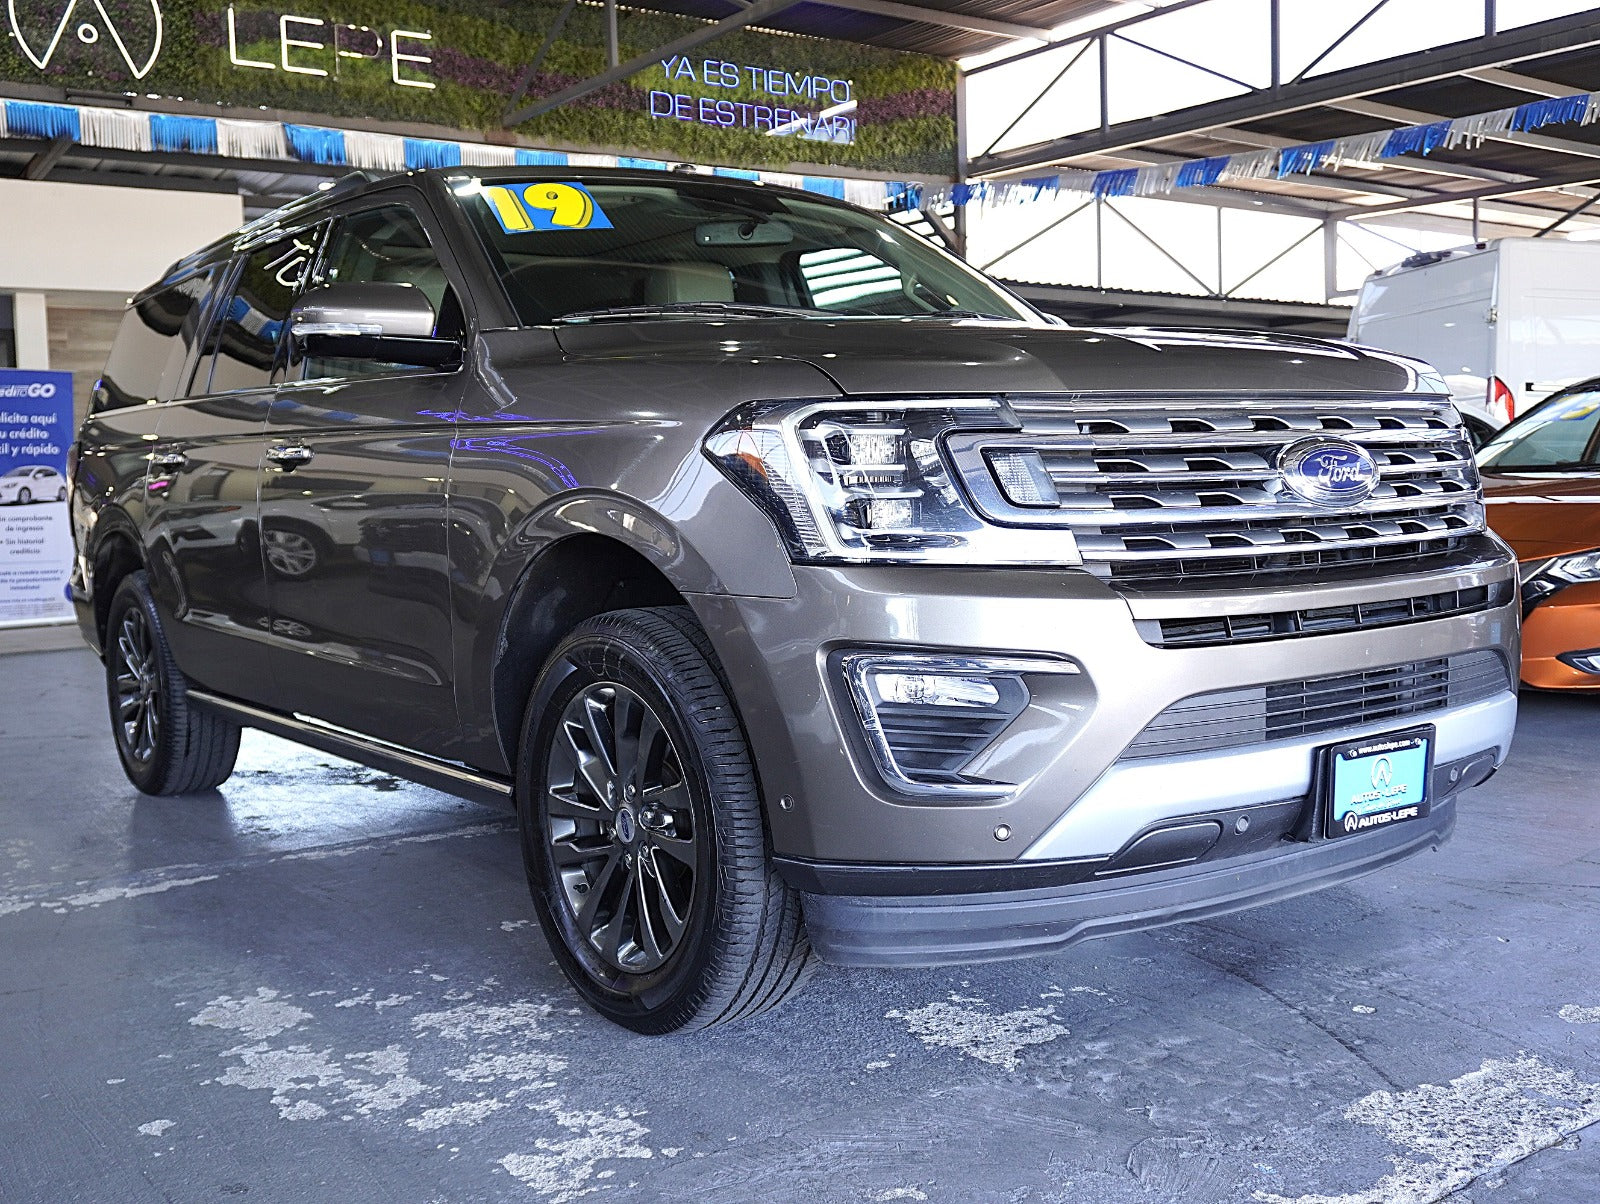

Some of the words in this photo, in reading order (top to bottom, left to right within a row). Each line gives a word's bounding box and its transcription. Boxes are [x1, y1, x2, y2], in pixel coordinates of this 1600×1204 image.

[227, 6, 437, 90] LEPE
[661, 54, 697, 81] YA
[703, 59, 740, 88] ES
[744, 66, 850, 104] TIEMPO
[650, 90, 693, 121] DE
[488, 182, 595, 231] 19
[9, 427, 49, 440] crédito
[30, 412, 57, 426] aquí
[11, 446, 19, 457] y
[21, 443, 60, 457] rápido
[1317, 454, 1365, 487] Ford
[1358, 806, 1418, 828] AUTOS-LEPE
